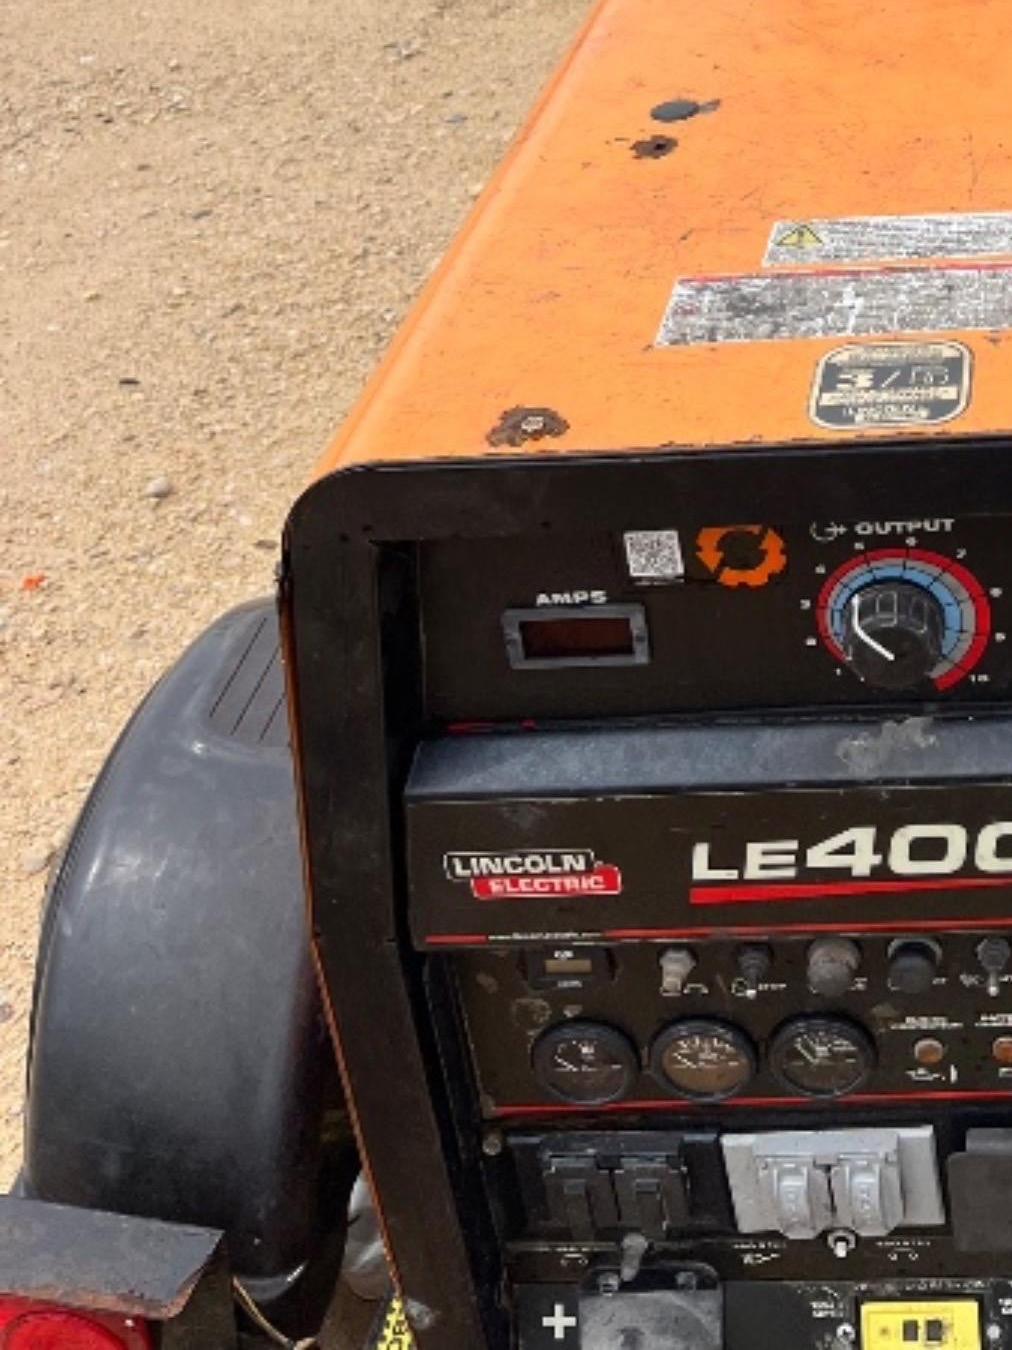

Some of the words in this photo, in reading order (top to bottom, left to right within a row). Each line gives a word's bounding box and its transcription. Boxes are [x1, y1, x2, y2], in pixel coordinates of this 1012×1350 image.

[854, 518, 955, 535] OUTPUT
[535, 589, 608, 607] AMPS
[452, 854, 587, 877] LINCOLN
[489, 875, 606, 893] ELECTRIC
